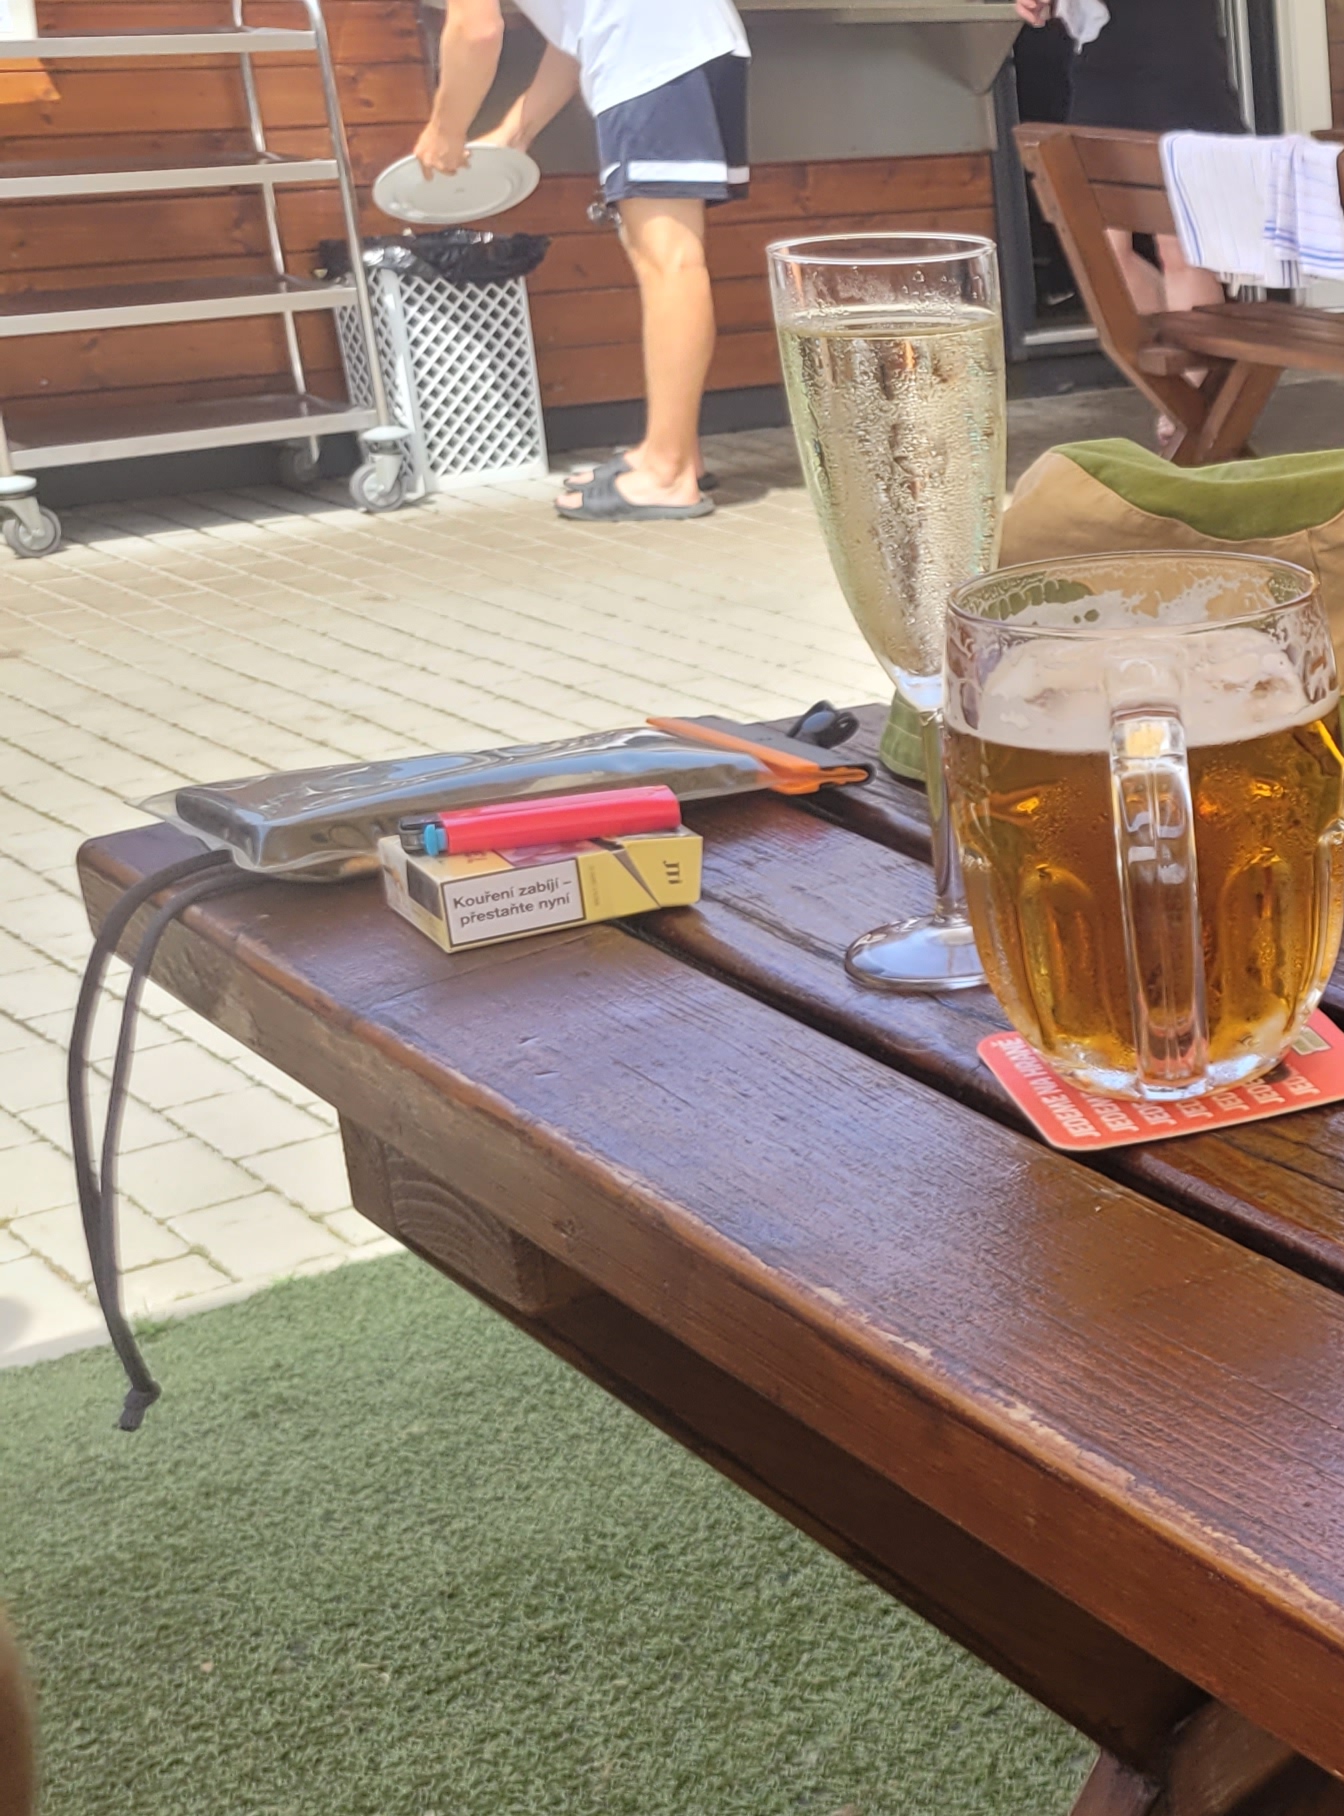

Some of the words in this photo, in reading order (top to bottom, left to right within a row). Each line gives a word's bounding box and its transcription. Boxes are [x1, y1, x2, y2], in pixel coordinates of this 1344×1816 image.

[453, 886, 515, 909] Kouření
[519, 877, 560, 897] zabíjí
[459, 902, 535, 928] přestaňte
[539, 892, 570, 910] nyní
[989, 1036, 1048, 1078] HRANĚ
[1029, 1076, 1063, 1096] NA
[1041, 1093, 1102, 1138] JEDEME
